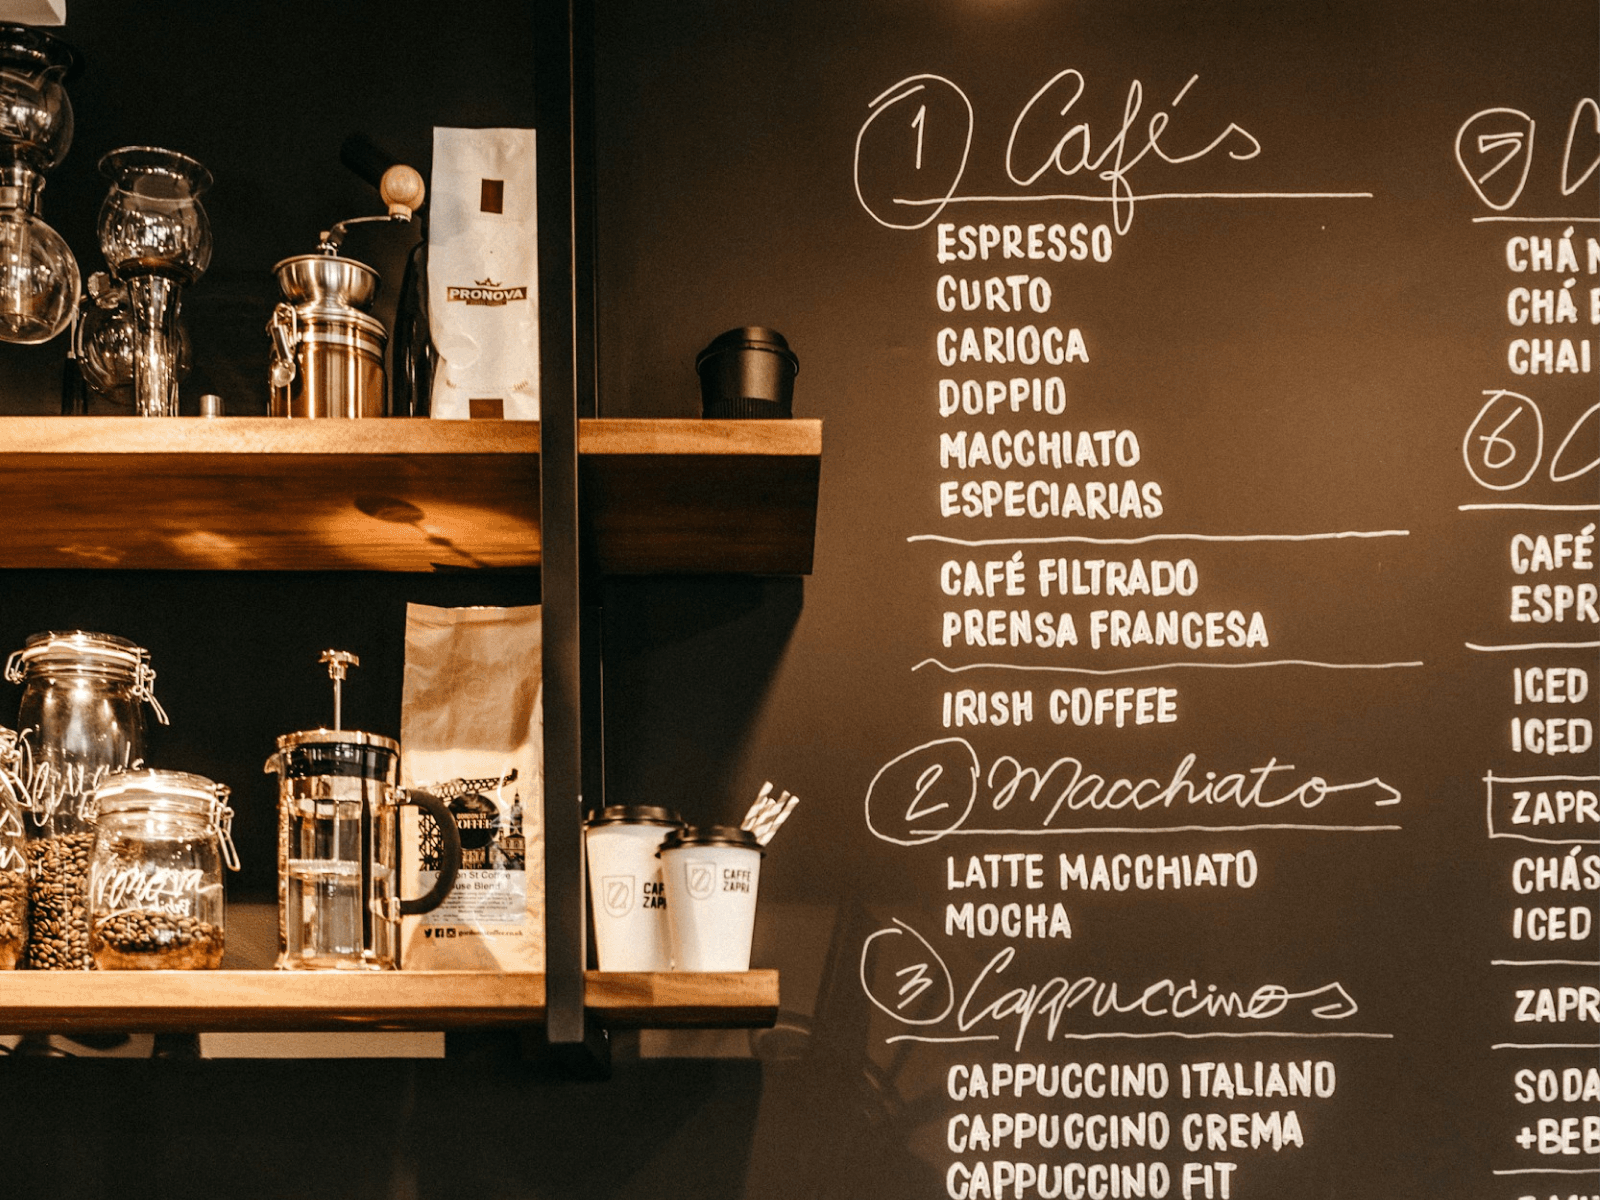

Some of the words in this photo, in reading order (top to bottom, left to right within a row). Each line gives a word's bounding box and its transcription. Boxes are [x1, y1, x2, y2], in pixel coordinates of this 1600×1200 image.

[911, 104, 926, 170] 1
[1005, 68, 1262, 236] Cafés
[936, 222, 1113, 264] ESPRESSO
[1505, 225, 1580, 273] CHÁ
[449, 287, 524, 302] PRONOVA
[936, 274, 1052, 314] CURTO
[1506, 277, 1578, 326] CHÁ
[936, 324, 1090, 367] CARIOCA
[1507, 338, 1591, 375] CHAI
[938, 376, 1067, 418] DOPPIO
[939, 429, 1141, 470] MACCHIATO
[1478, 405, 1524, 469] 6
[939, 479, 1164, 520] ESPECIARIAS
[1510, 522, 1596, 575] CAFÉ
[940, 549, 1026, 598] CAFÉ
[1038, 557, 1199, 598] FILTRADO
[942, 608, 1079, 649] PRENSA
[1089, 609, 1269, 650] FRANCESA
[1513, 666, 1589, 705] ICED
[942, 688, 1033, 728] IRISH
[1049, 686, 1178, 729] COFFEE
[1511, 717, 1593, 756] ICED
[904, 763, 950, 822] 2
[987, 752, 1402, 826] Macchiatos
[457, 819, 493, 829] OFFEE
[642, 882, 665, 896] CAF
[947, 853, 1044, 891] LATTE
[1058, 849, 1258, 892] MACCHIATO
[1512, 844, 1600, 895] CHÁS
[642, 896, 667, 910] ZAP
[945, 902, 1072, 939] MOCHA
[1512, 906, 1592, 941] ICED
[895, 963, 933, 1010] 3
[957, 946, 1359, 1052] Cappuccinos
[947, 1062, 1169, 1101] CAPPUCCINO
[1180, 1059, 1336, 1100] ITALIANO
[947, 1111, 1170, 1154] CAPPUCCINO
[1181, 1110, 1304, 1152] CREMA
[1182, 1161, 1238, 1200] FIT
